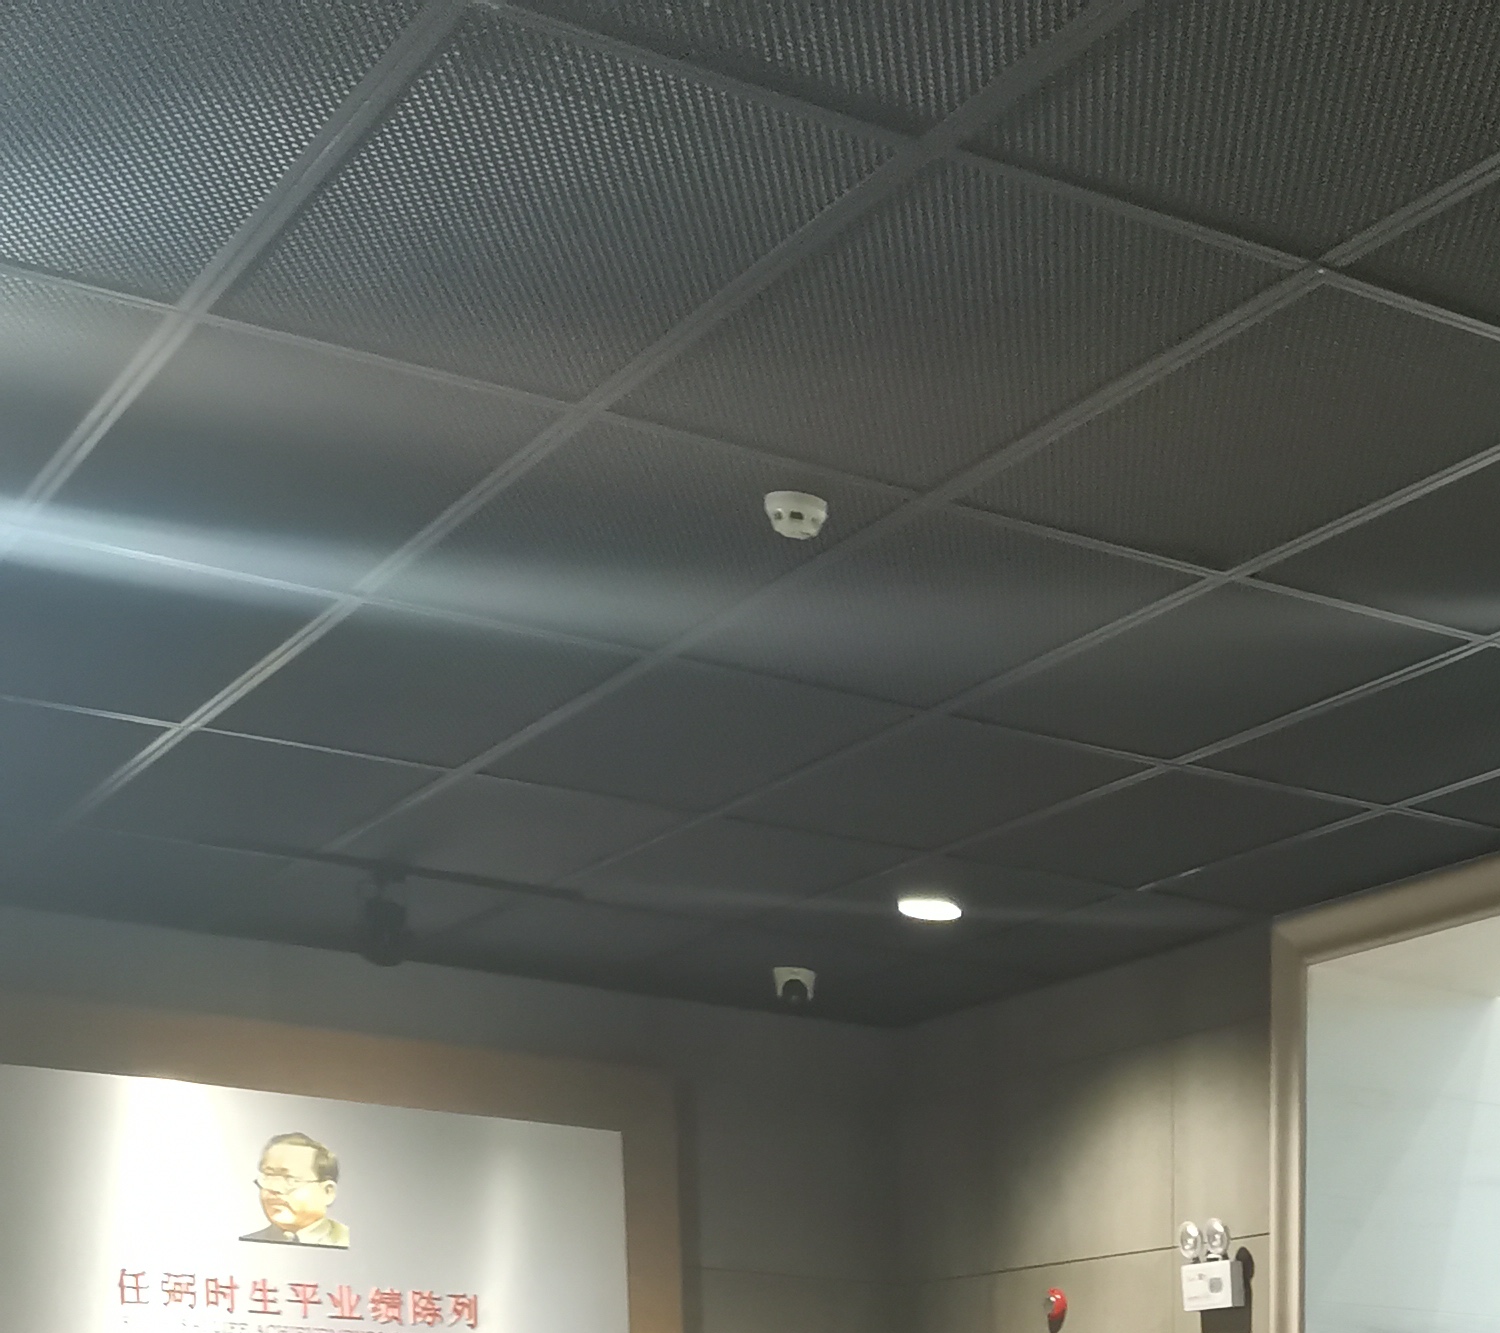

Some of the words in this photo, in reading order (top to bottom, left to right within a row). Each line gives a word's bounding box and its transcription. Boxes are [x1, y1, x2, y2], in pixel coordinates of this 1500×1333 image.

[117, 1268, 480, 1330] 任弼时生平业绩陈列
